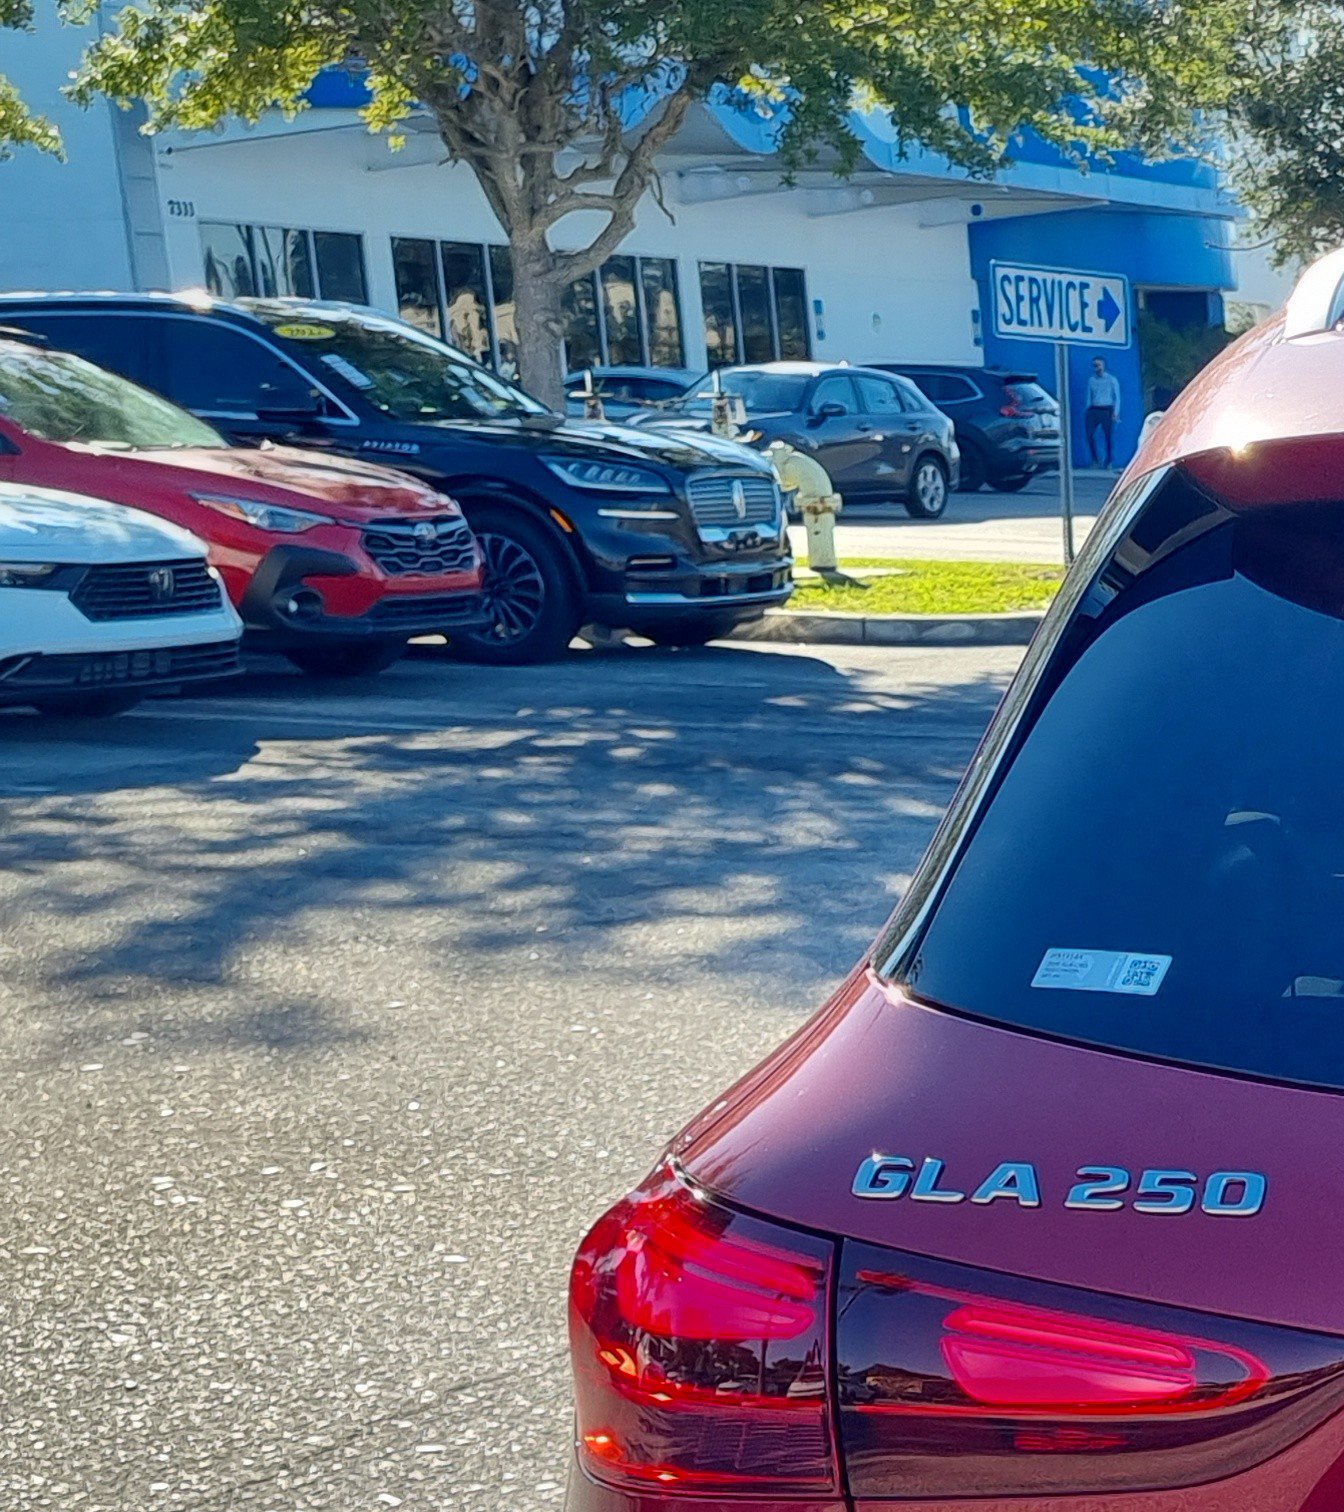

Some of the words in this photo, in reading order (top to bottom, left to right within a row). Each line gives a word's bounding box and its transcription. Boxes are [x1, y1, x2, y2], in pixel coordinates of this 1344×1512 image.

[1000, 274, 1093, 333] SERVICE
[851, 1153, 1040, 1207] GLA
[1063, 1165, 1268, 1216] 250
